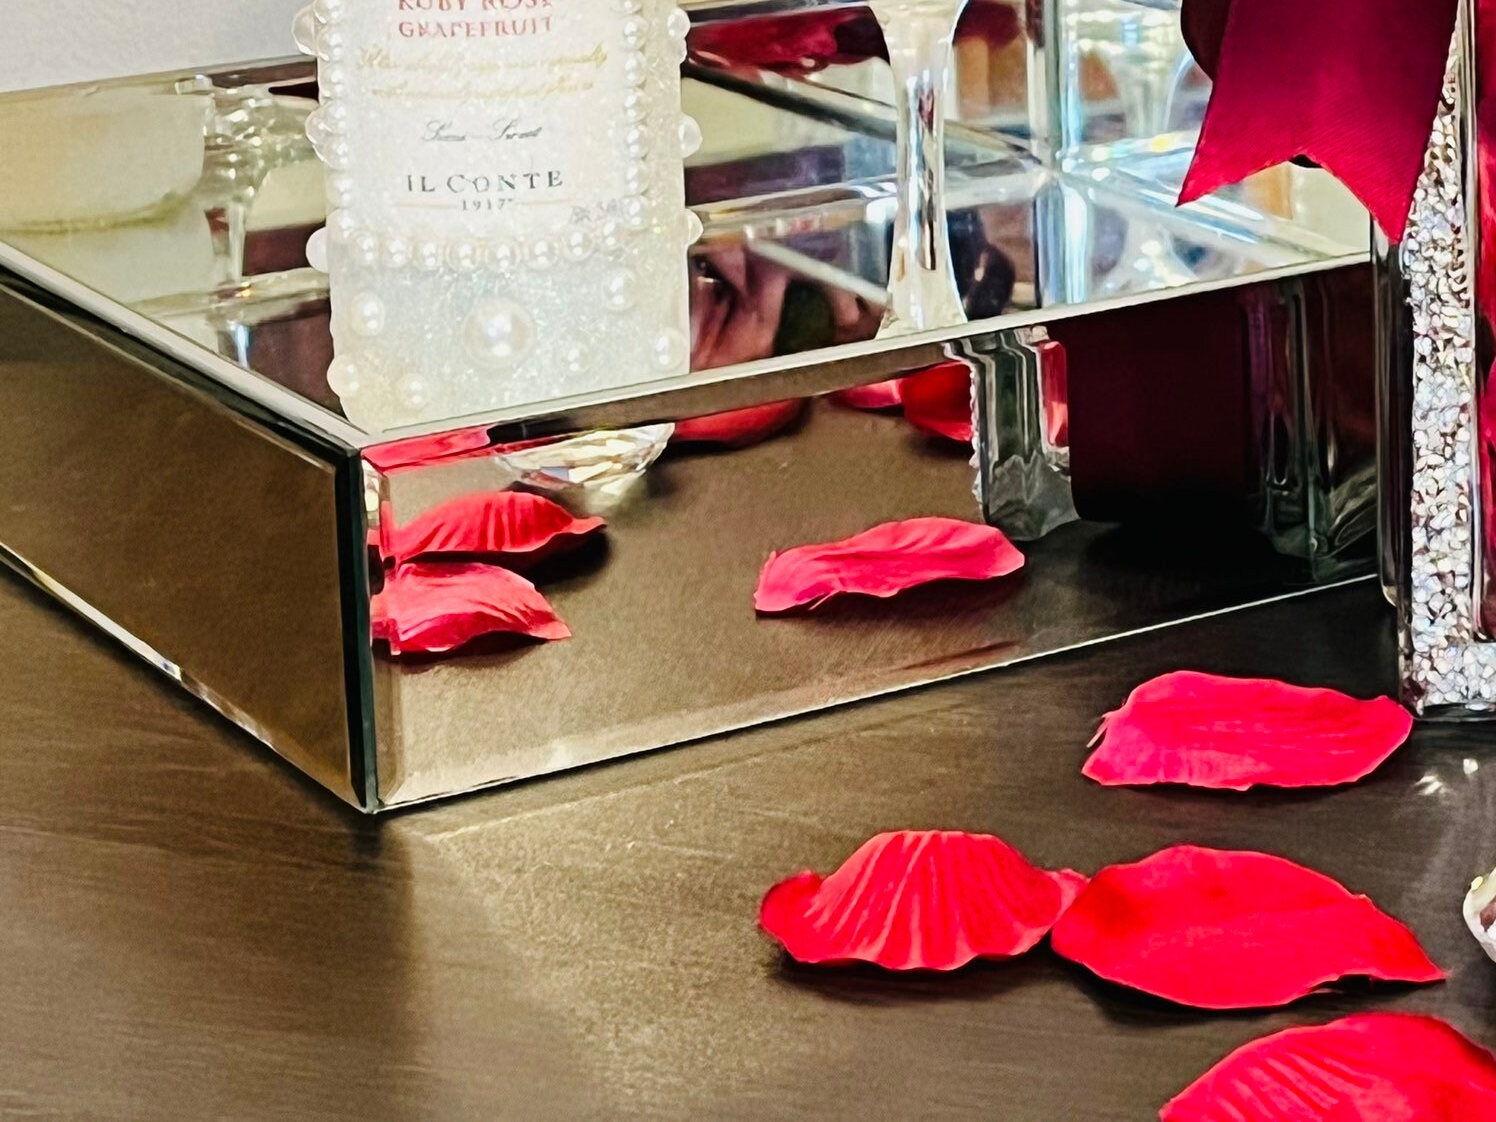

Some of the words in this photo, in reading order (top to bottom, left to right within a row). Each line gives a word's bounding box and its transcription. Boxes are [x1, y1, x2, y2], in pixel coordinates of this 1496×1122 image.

[398, 15, 552, 38] GRAPEFRUIT
[406, 173, 436, 192] IL
[446, 169, 564, 194] CONTE
